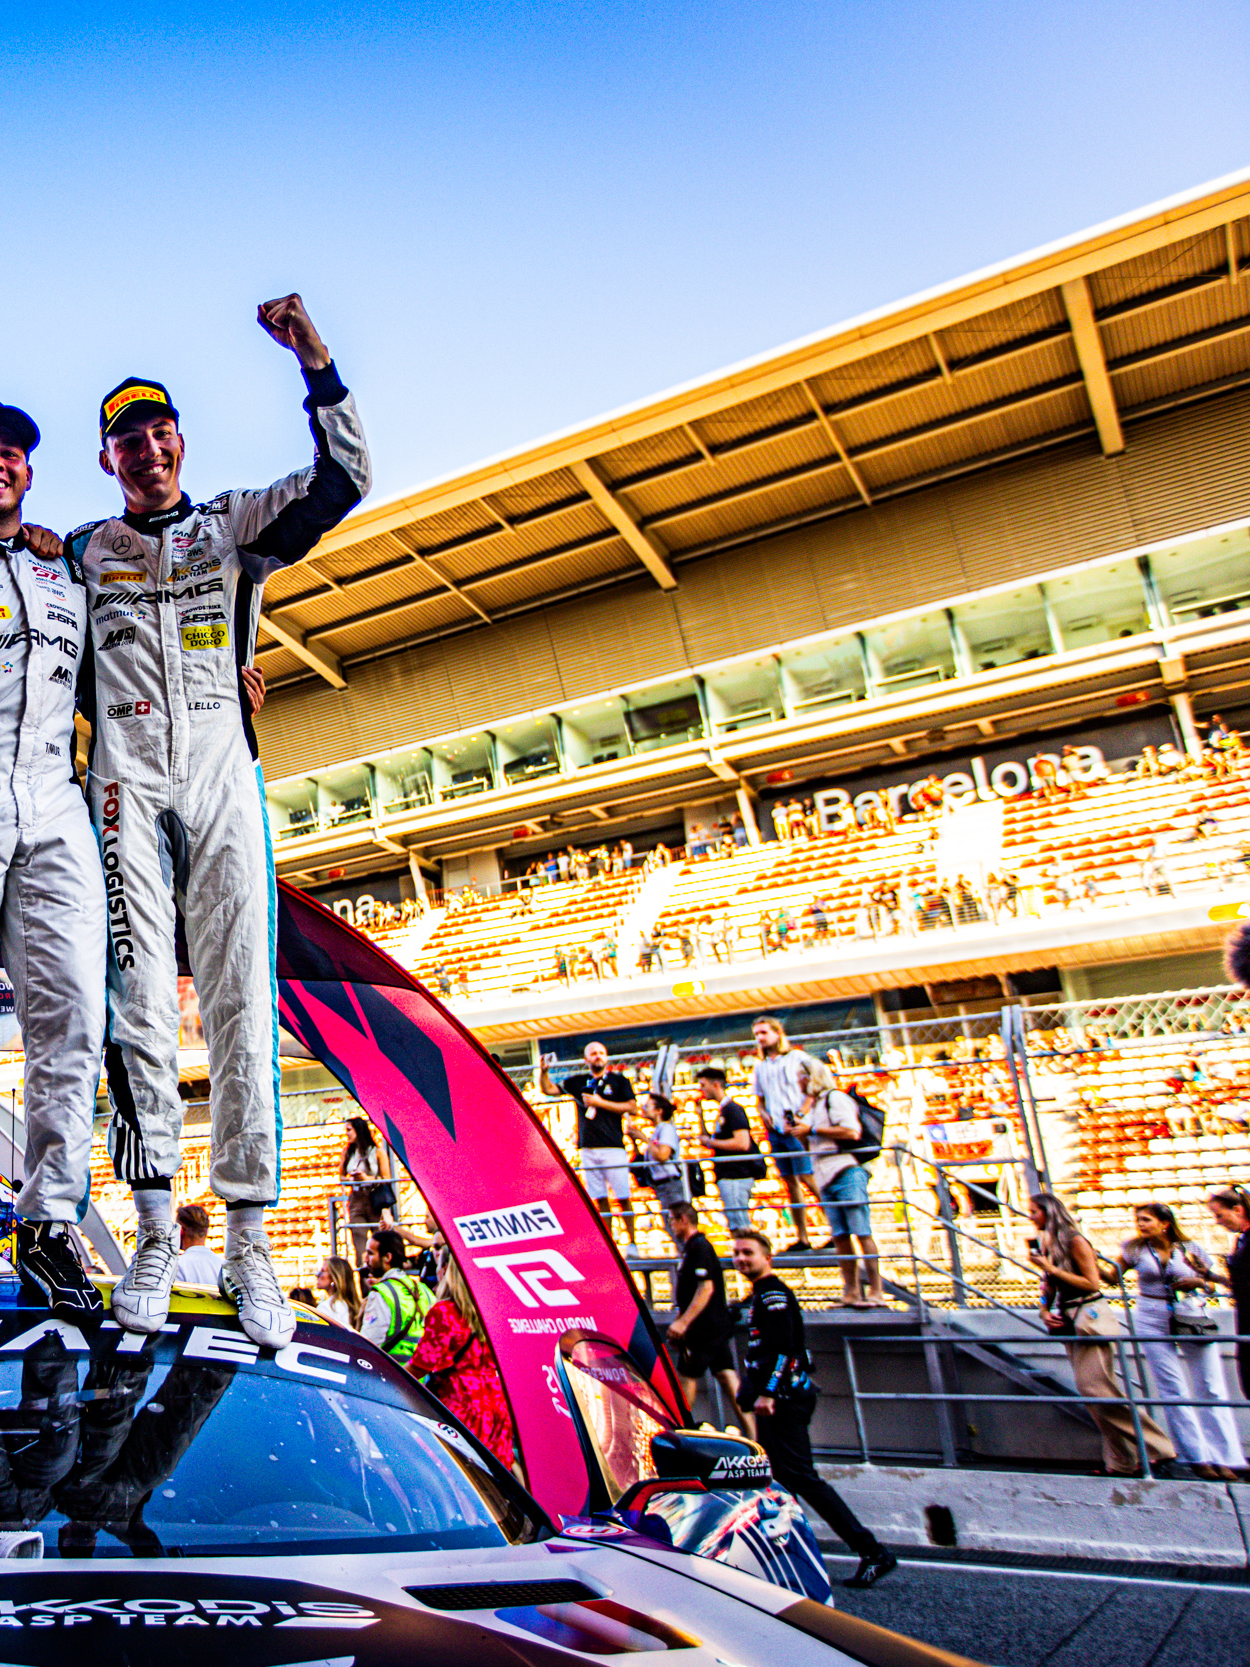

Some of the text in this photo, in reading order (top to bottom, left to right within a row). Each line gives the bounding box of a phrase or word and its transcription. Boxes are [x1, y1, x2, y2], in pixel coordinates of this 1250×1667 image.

[102, 573, 144, 583] PIRELLI
[96, 610, 135, 626] matmut
[185, 630, 225, 641] CHICCO
[5, 629, 79, 660] AMG
[107, 704, 133, 717] OMP
[188, 702, 221, 711] LELLO
[102, 781, 135, 972] FOX LOGISTICS
[728, 1468, 765, 1479] ASP TEAM
[112, 1613, 263, 1628] TEAM
